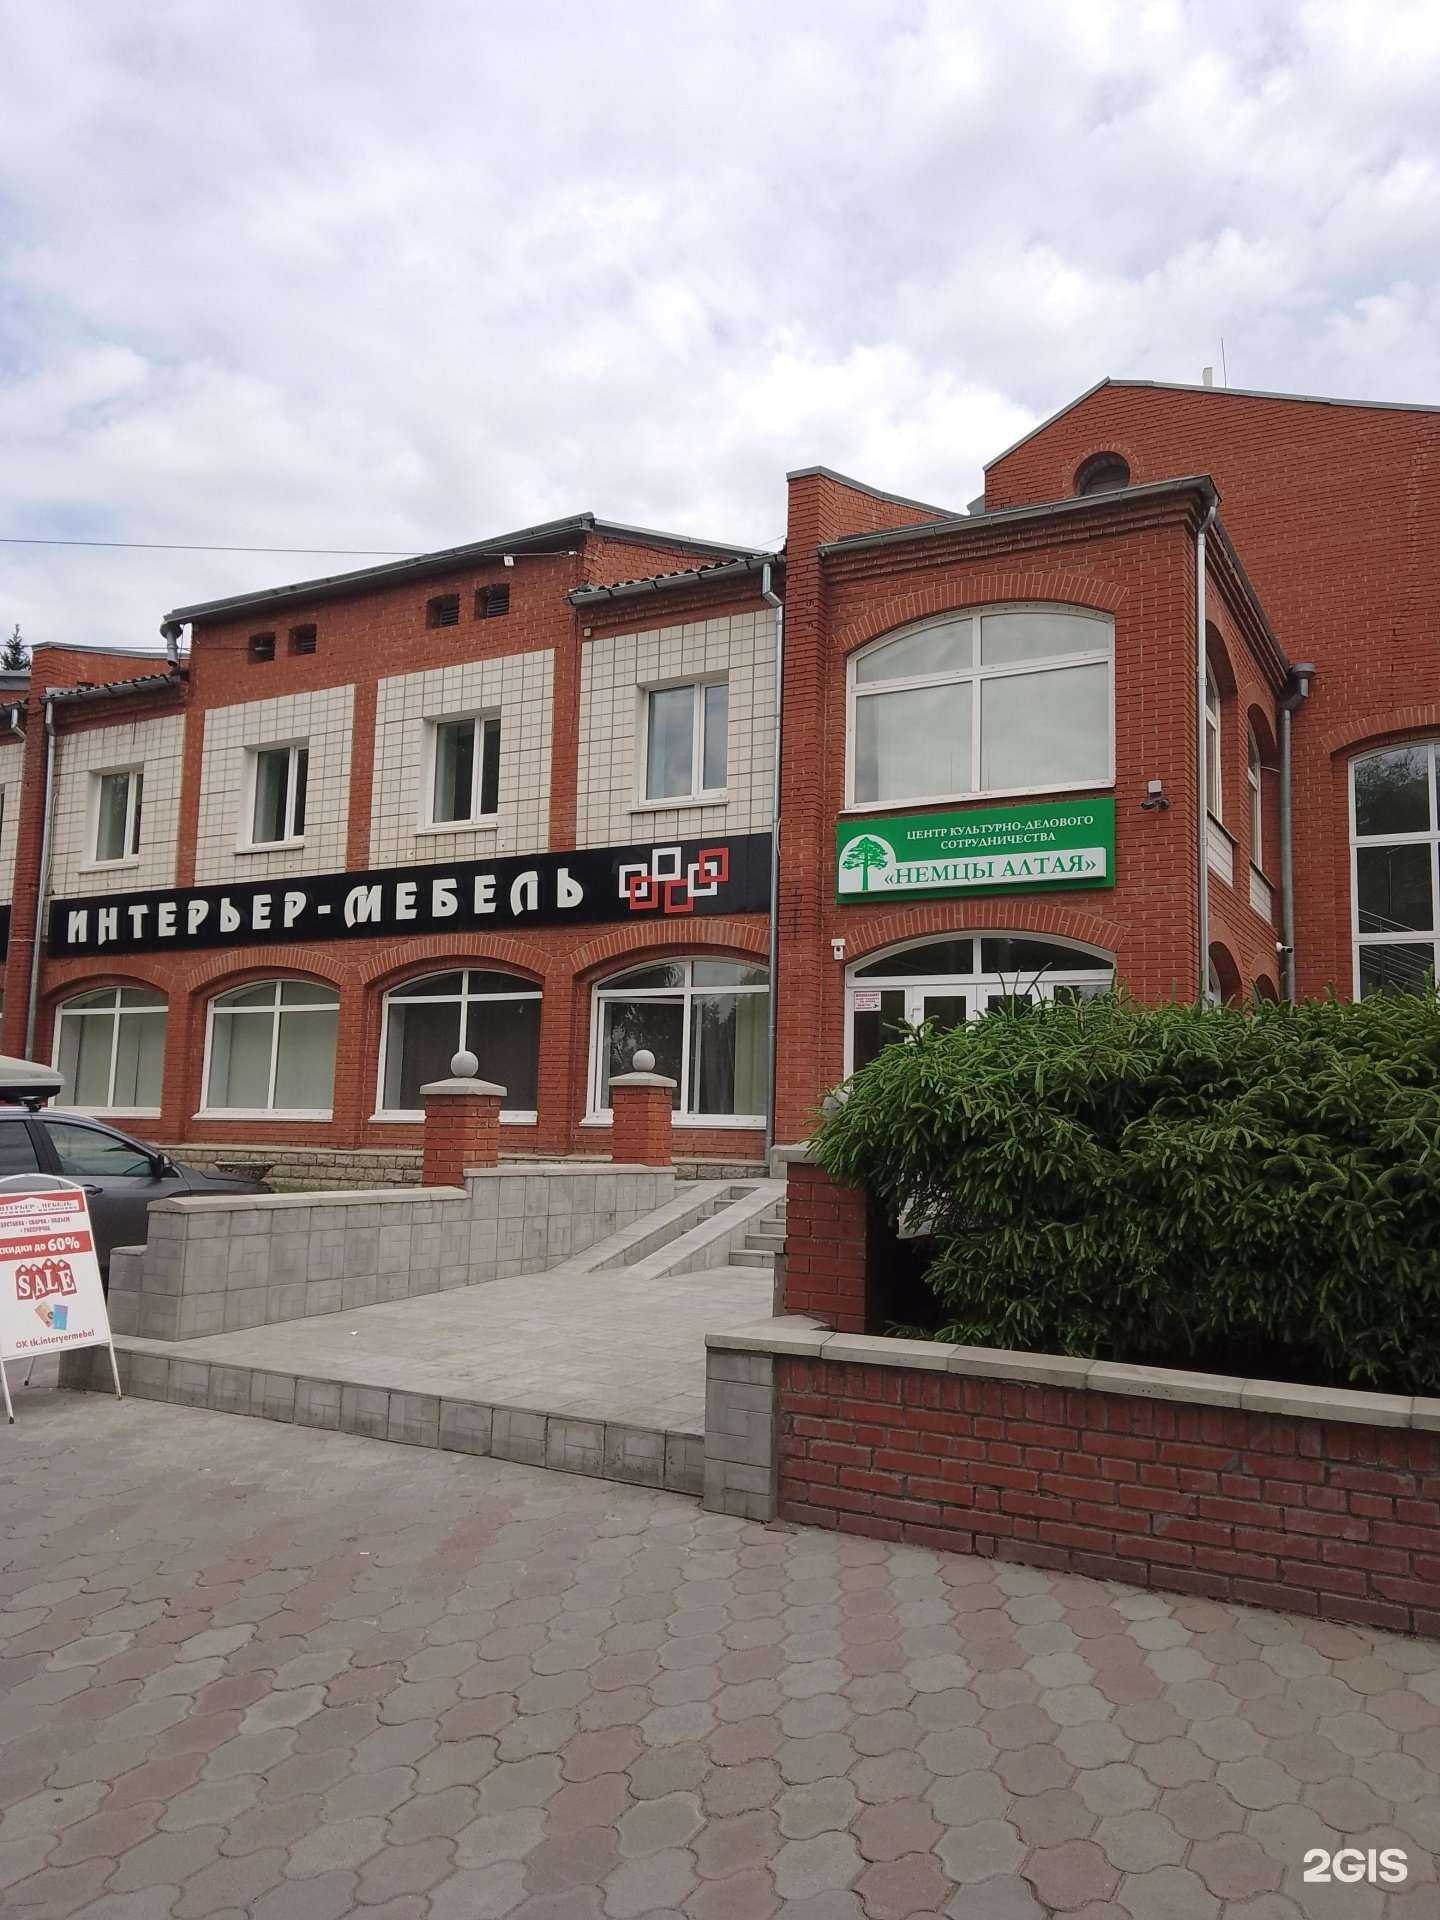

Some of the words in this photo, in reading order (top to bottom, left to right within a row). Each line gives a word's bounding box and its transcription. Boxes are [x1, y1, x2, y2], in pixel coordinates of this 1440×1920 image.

[906, 827, 948, 840] ЦЕНТР
[950, 815, 1094, 837] КУЛЬТУРНО-ДЕЛОВОГО
[940, 832, 1056, 850] СОТРУДНИЧЕСТВА
[884, 861, 994, 885] «НЕМЦЫ
[1002, 854, 1097, 877] АЛТАЯ»
[48, 1236, 80, 1252] 60%
[18, 1268, 75, 1297] SALE
